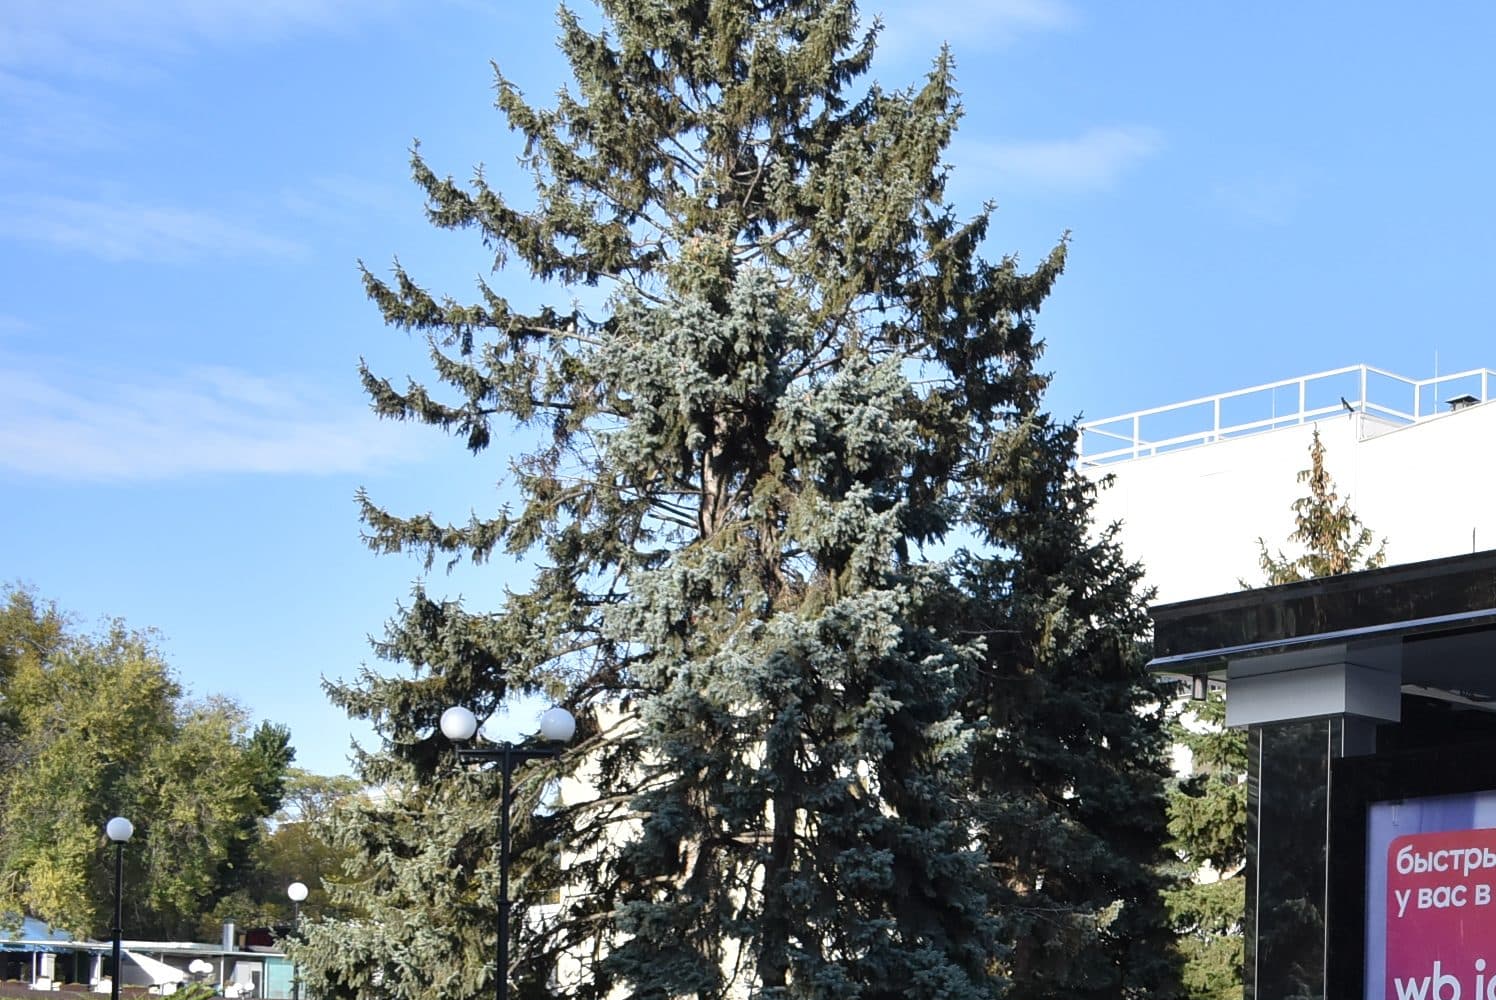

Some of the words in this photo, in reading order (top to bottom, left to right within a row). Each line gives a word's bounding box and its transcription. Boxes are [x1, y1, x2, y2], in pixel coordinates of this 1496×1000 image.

[1394, 888, 1412, 918] у
[1417, 885, 1468, 910] вас
[1474, 883, 1492, 906] в
